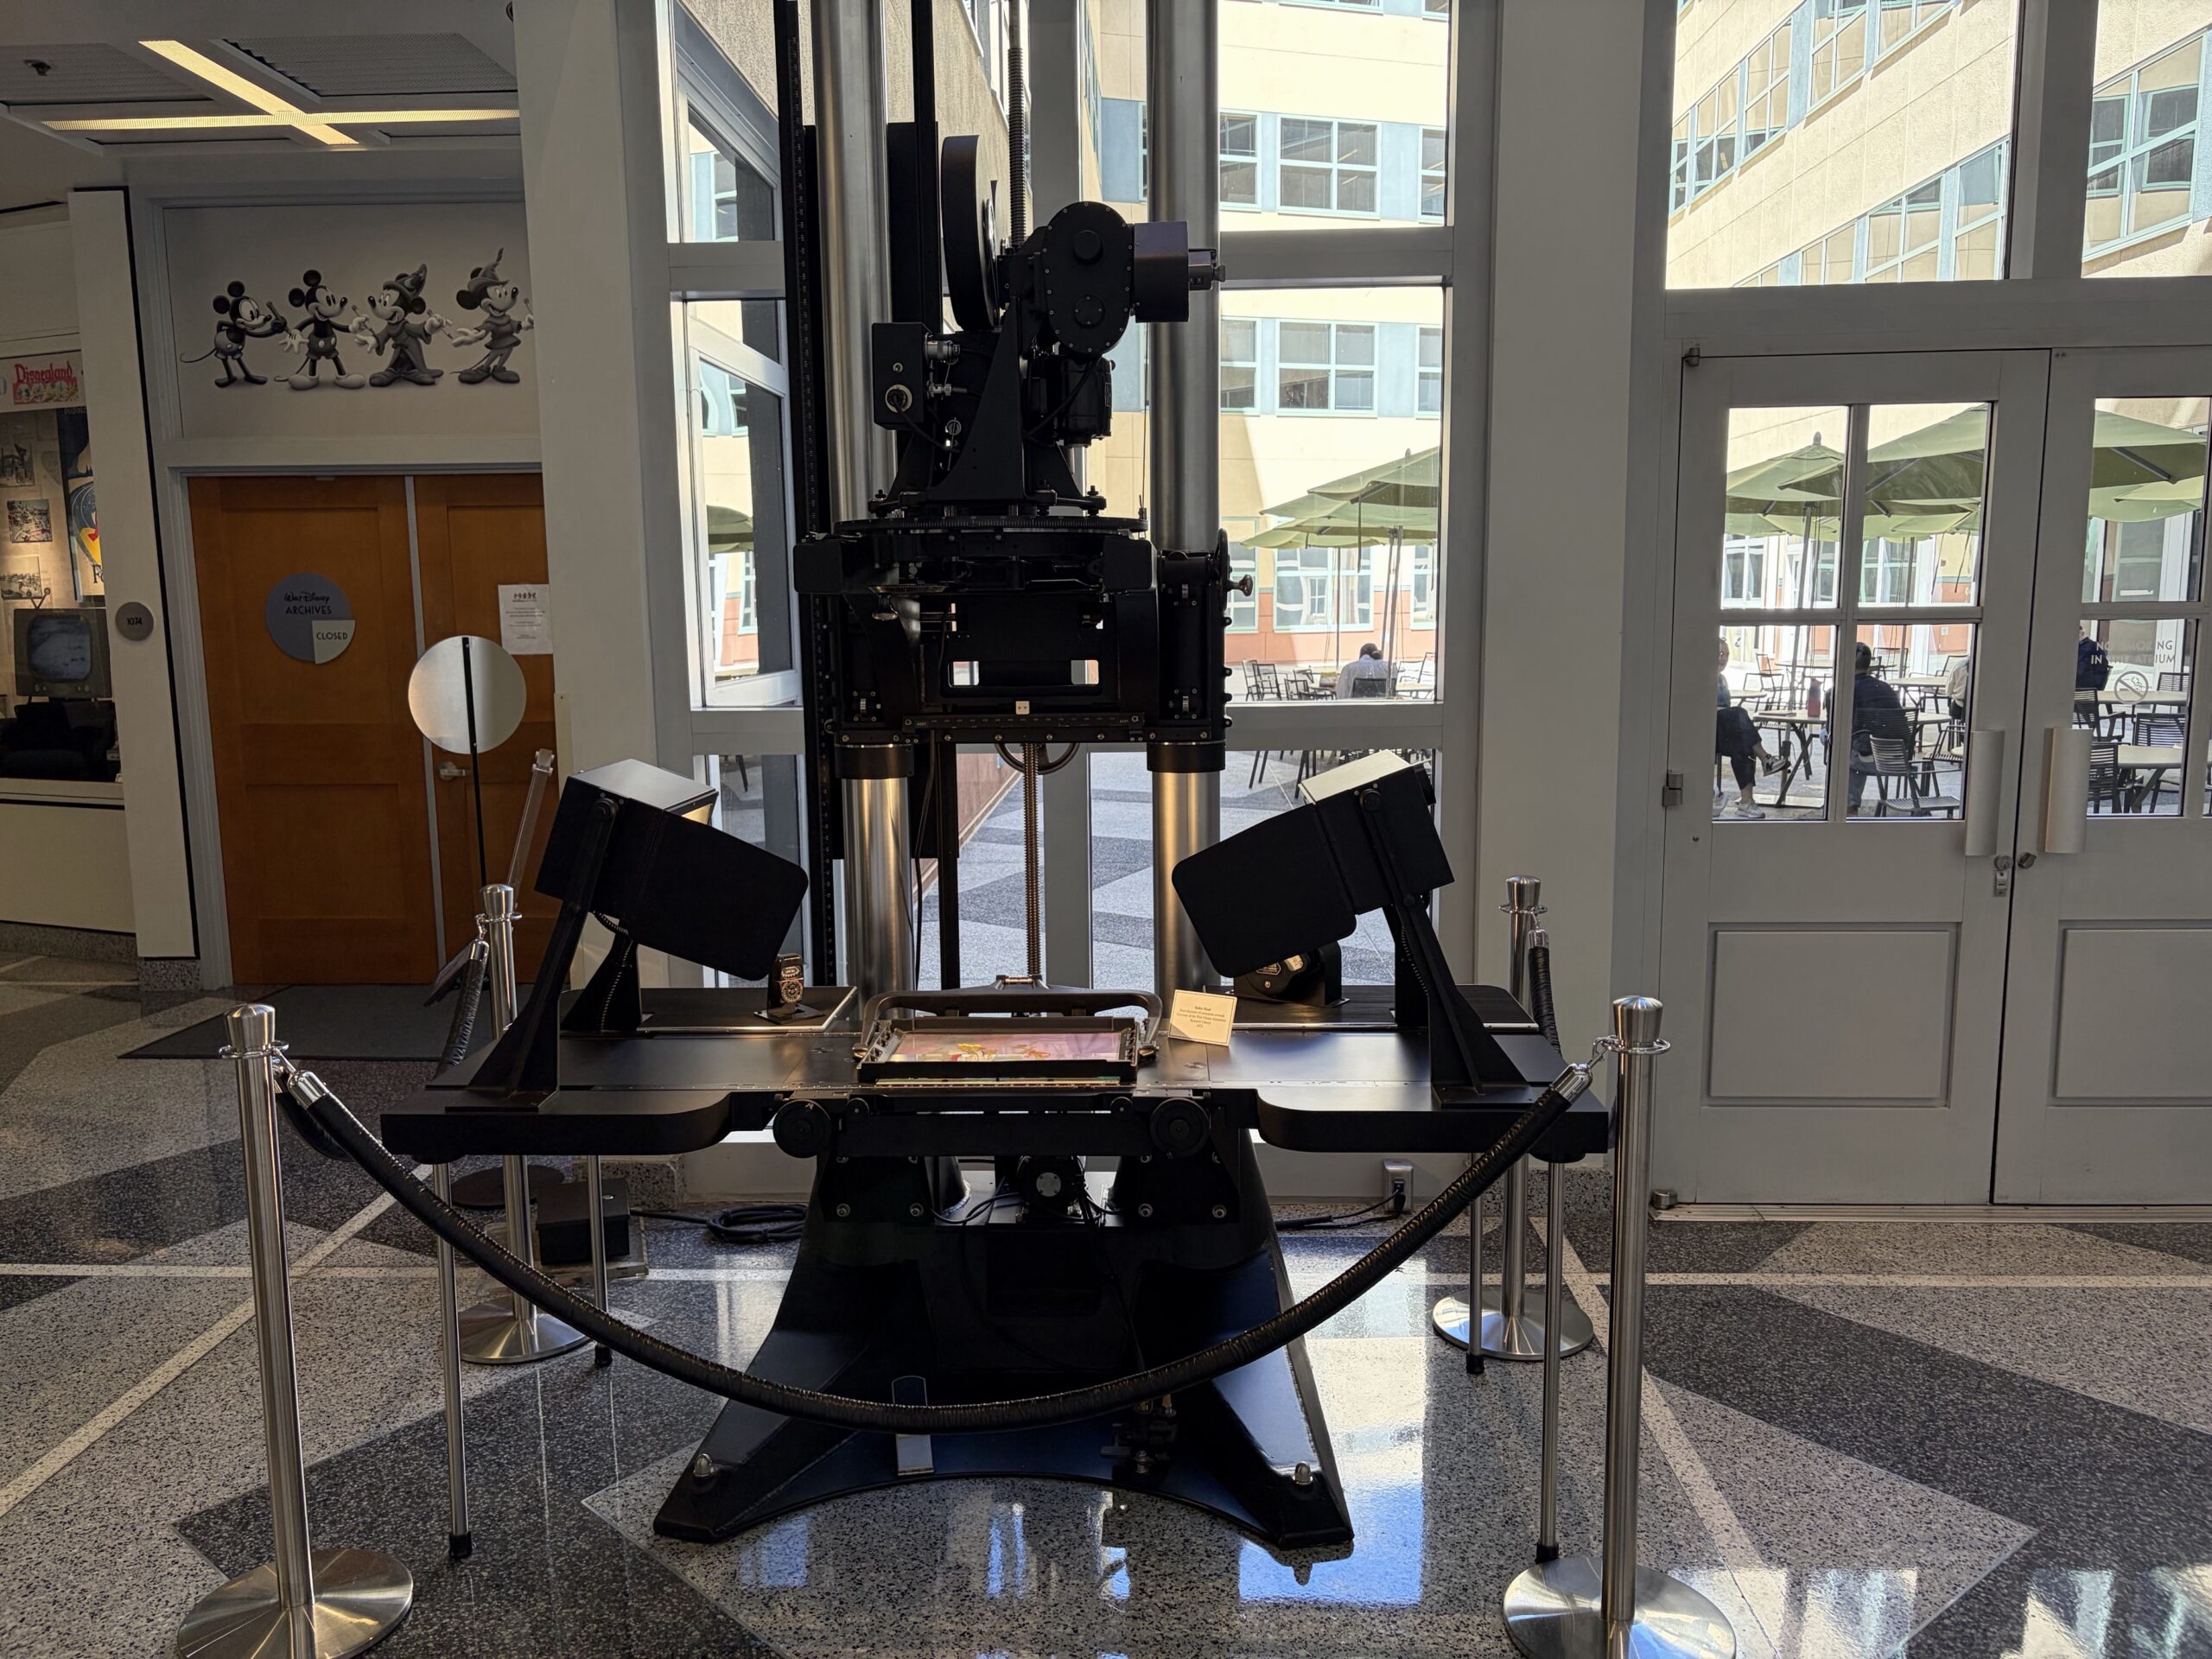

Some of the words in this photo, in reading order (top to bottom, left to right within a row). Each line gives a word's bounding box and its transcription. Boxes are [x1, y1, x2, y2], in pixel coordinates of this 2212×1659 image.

[14, 360, 73, 384] Disneyland
[284, 591, 302, 602] Walt
[301, 591, 330, 605] Disney
[285, 606, 332, 615] ARCHIVES
[316, 632, 348, 640] CLOSED
[2096, 641, 2114, 651] NO
[2091, 655, 2102, 664] IN
